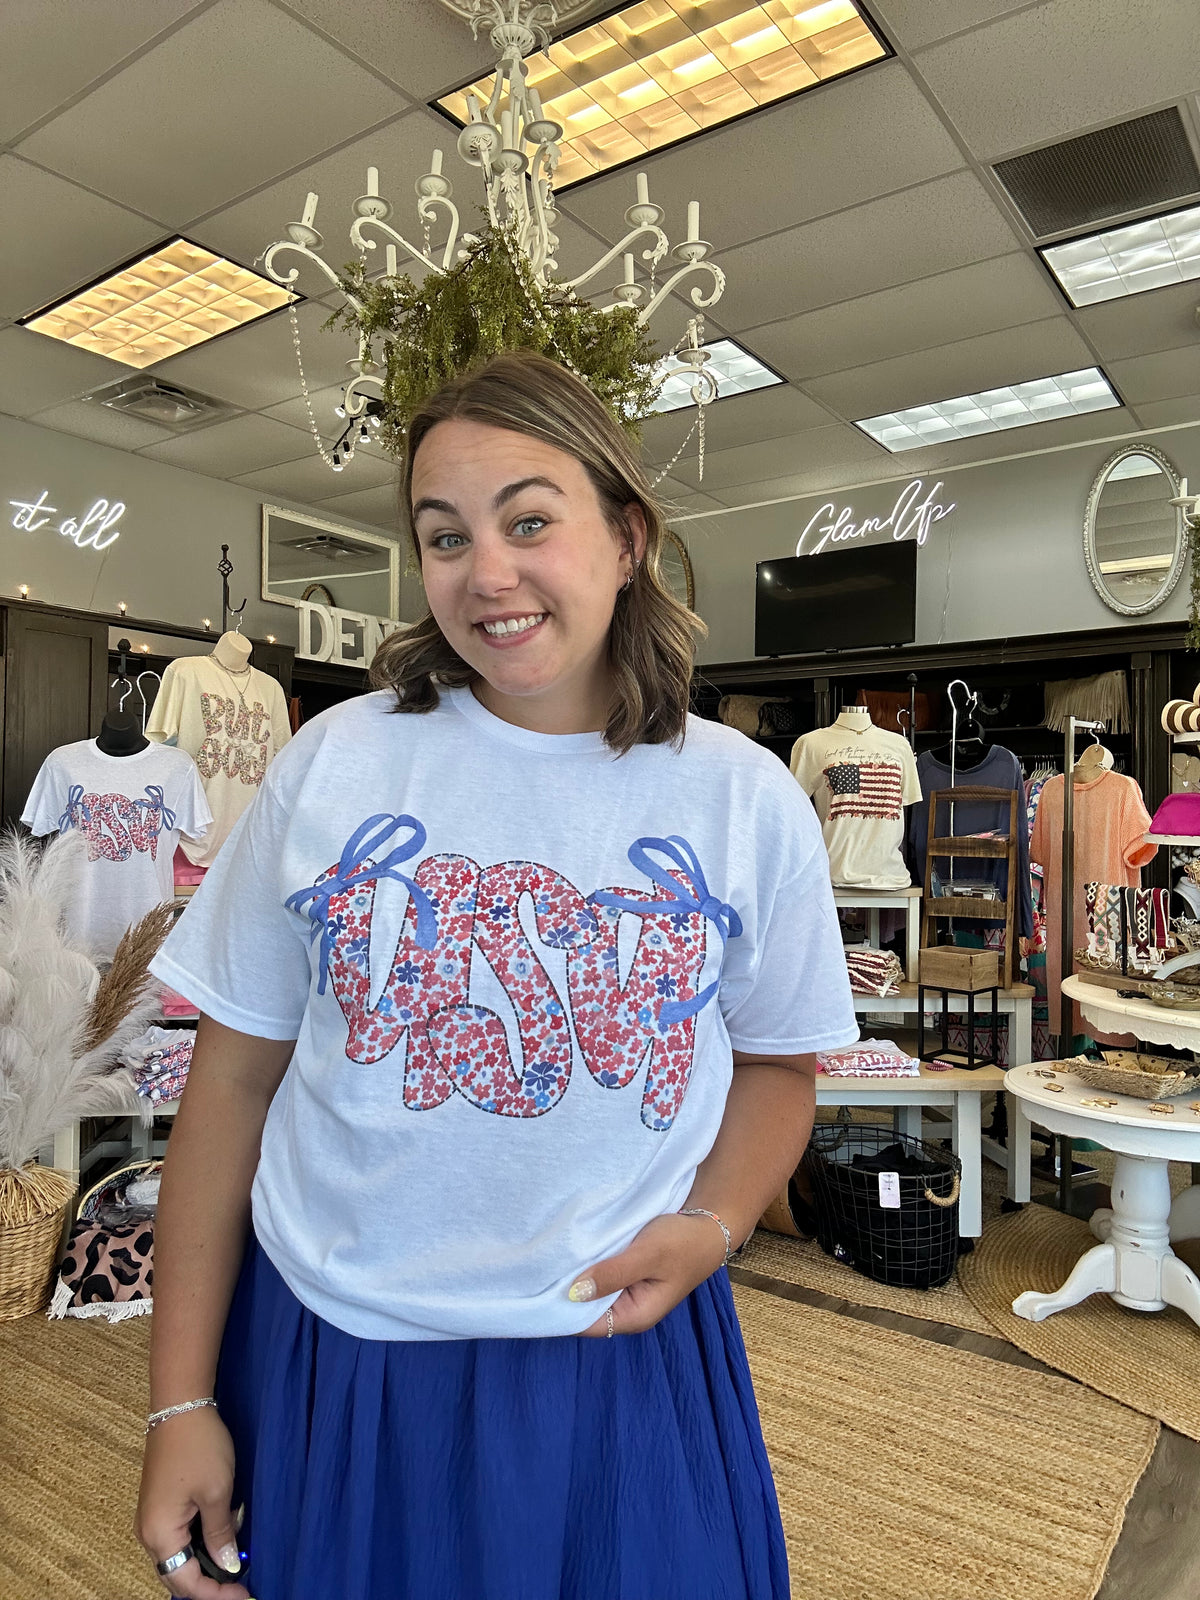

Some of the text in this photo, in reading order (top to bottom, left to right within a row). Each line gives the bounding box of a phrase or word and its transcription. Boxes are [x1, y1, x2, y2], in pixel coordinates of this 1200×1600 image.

[9, 490, 126, 550] it all
[796, 480, 956, 558] Glam Up
[294, 600, 411, 669] DEN
[312, 852, 708, 1132] USA
[857, 1053, 891, 1067] ALL
